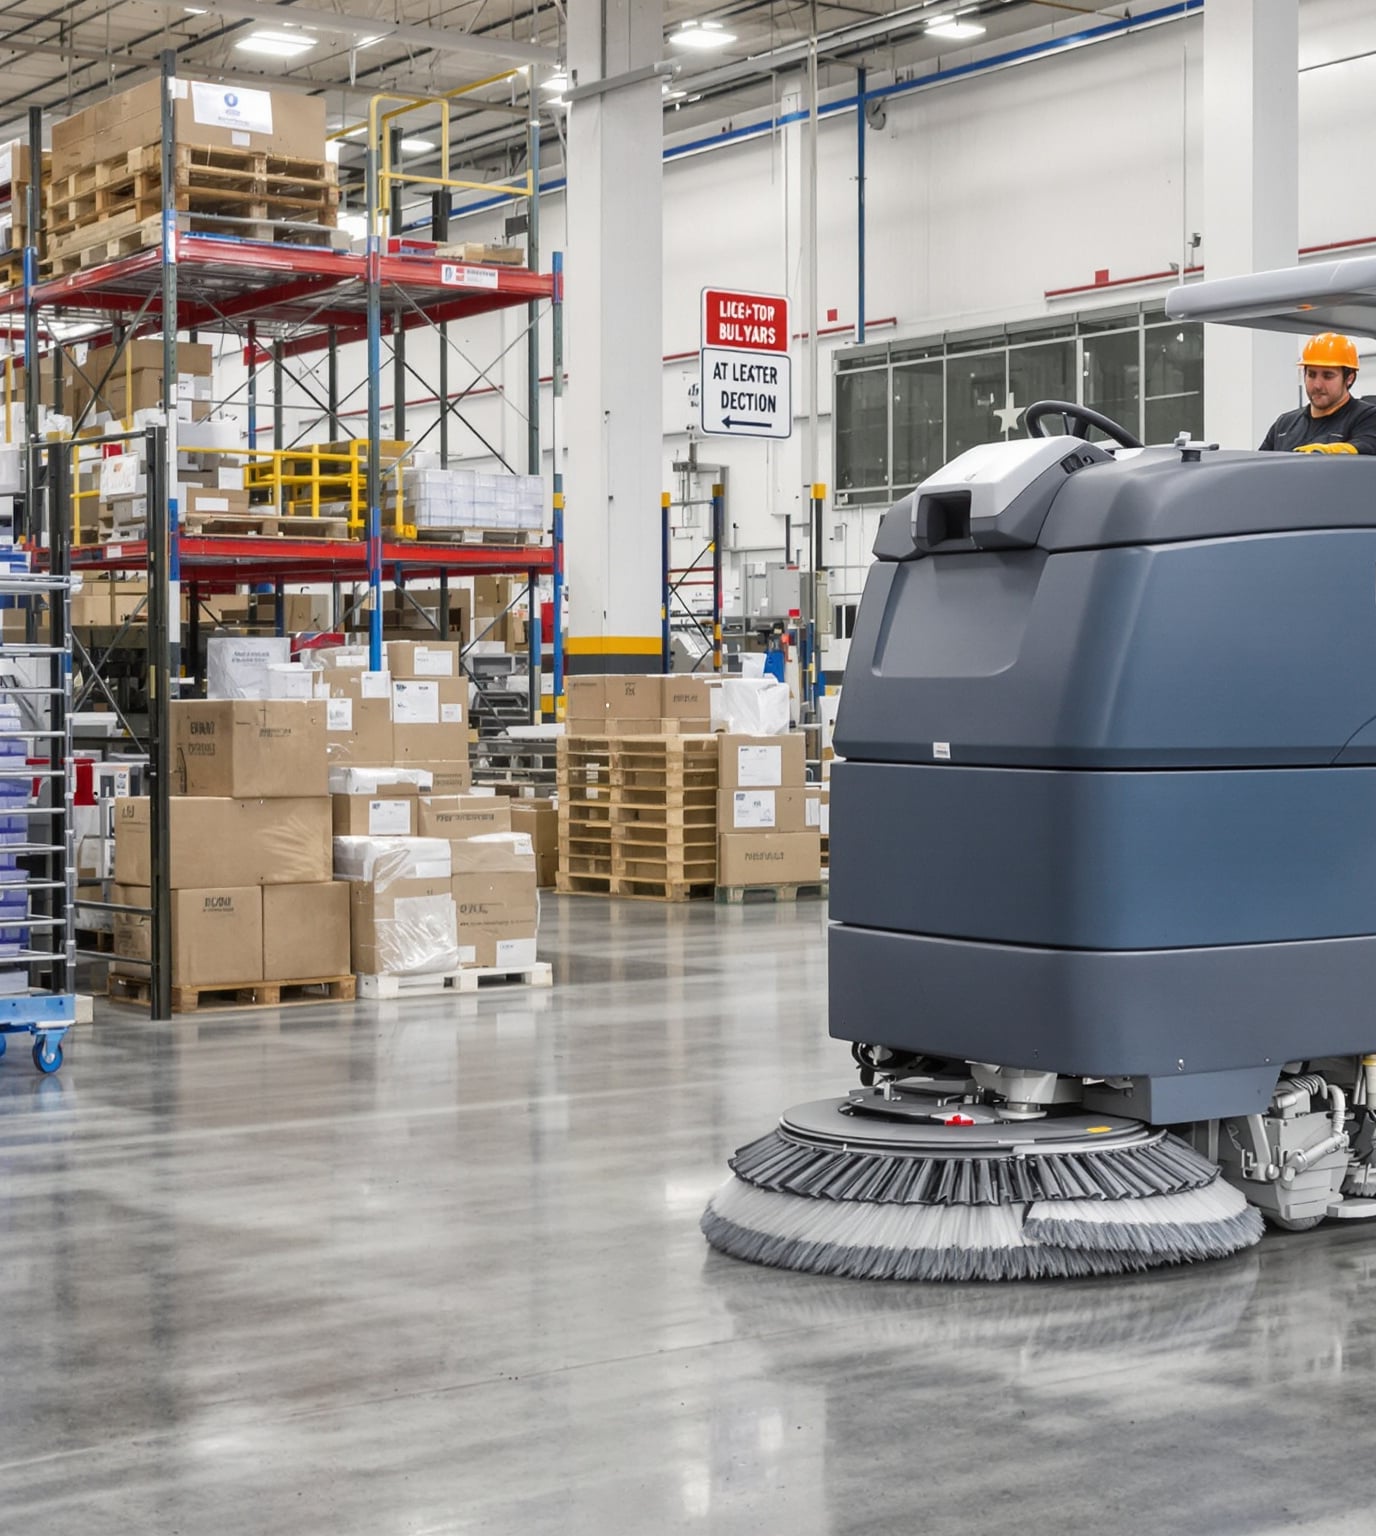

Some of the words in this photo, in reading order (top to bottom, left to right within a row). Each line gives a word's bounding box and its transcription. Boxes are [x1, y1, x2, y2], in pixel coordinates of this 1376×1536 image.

[719, 322, 776, 344] BULYARS
[713, 361, 729, 380] AT
[721, 390, 777, 413] DECTION
